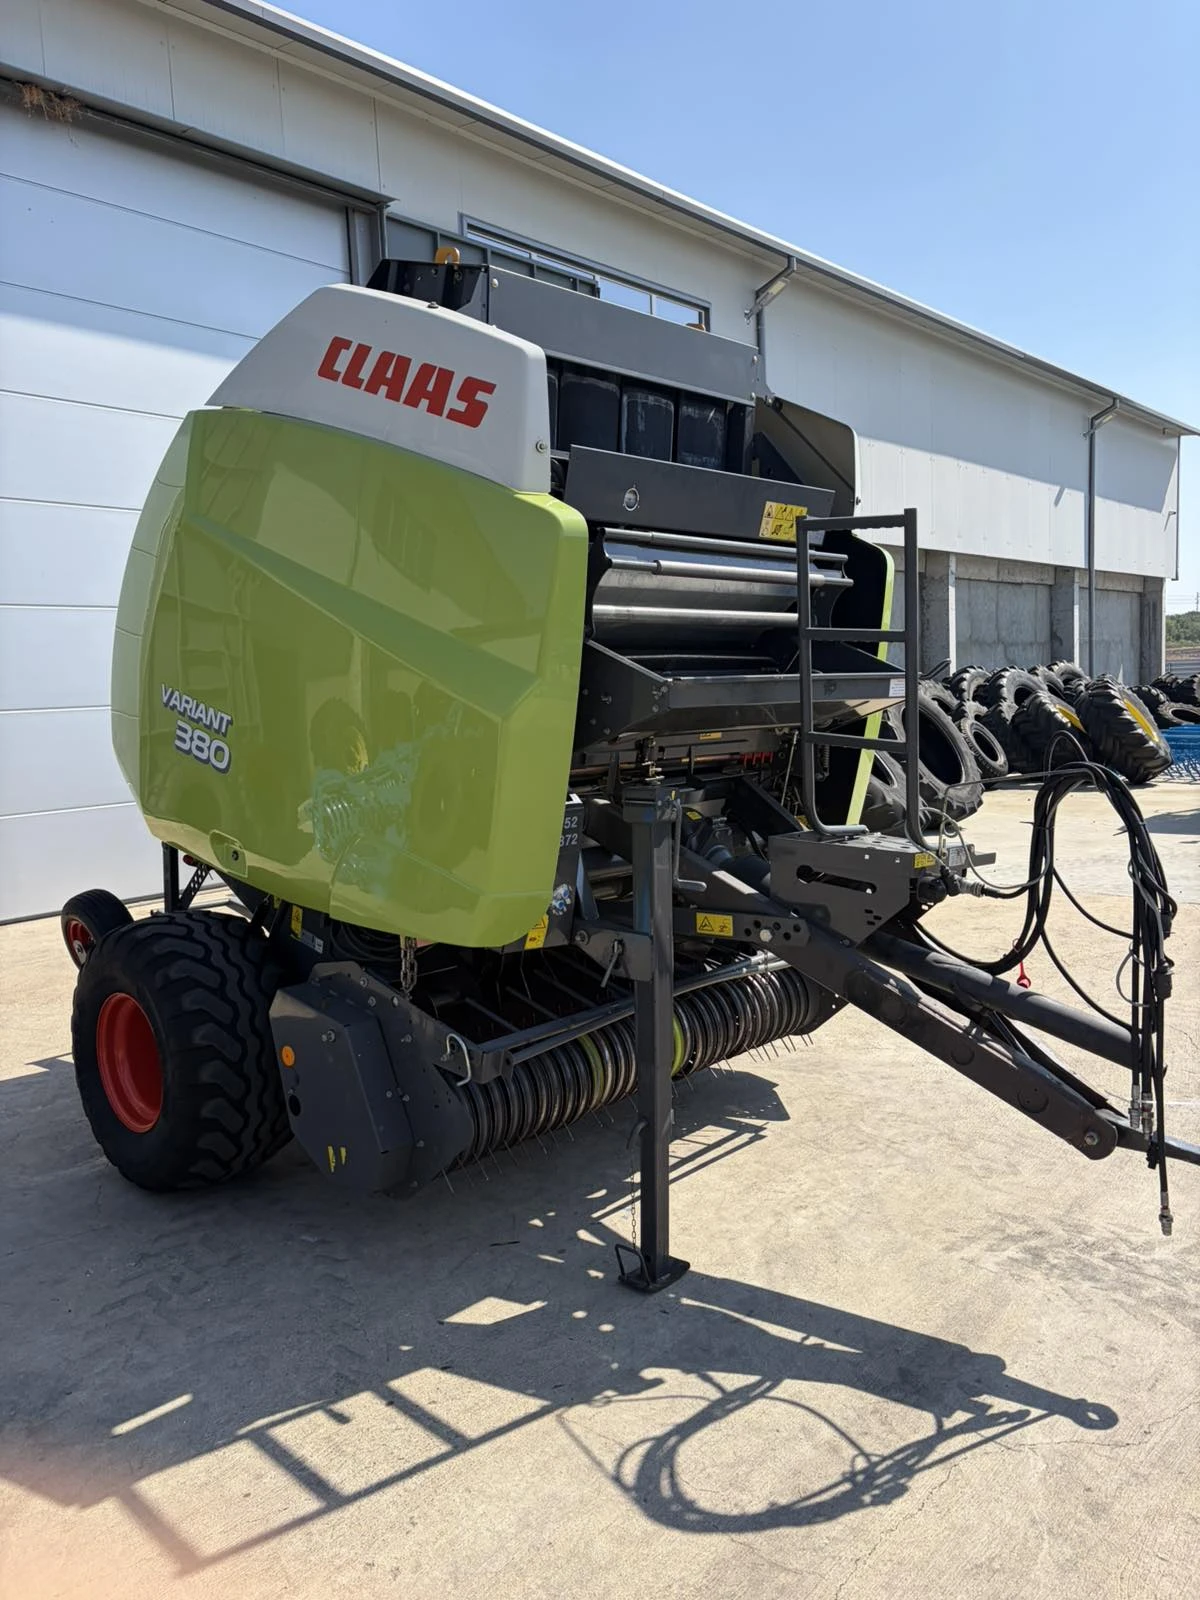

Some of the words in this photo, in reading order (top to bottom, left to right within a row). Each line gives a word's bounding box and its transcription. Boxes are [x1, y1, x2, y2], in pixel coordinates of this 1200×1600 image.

[318, 336, 497, 428] CLAAS
[161, 683, 232, 735] VARIANT
[174, 719, 231, 772] 380
